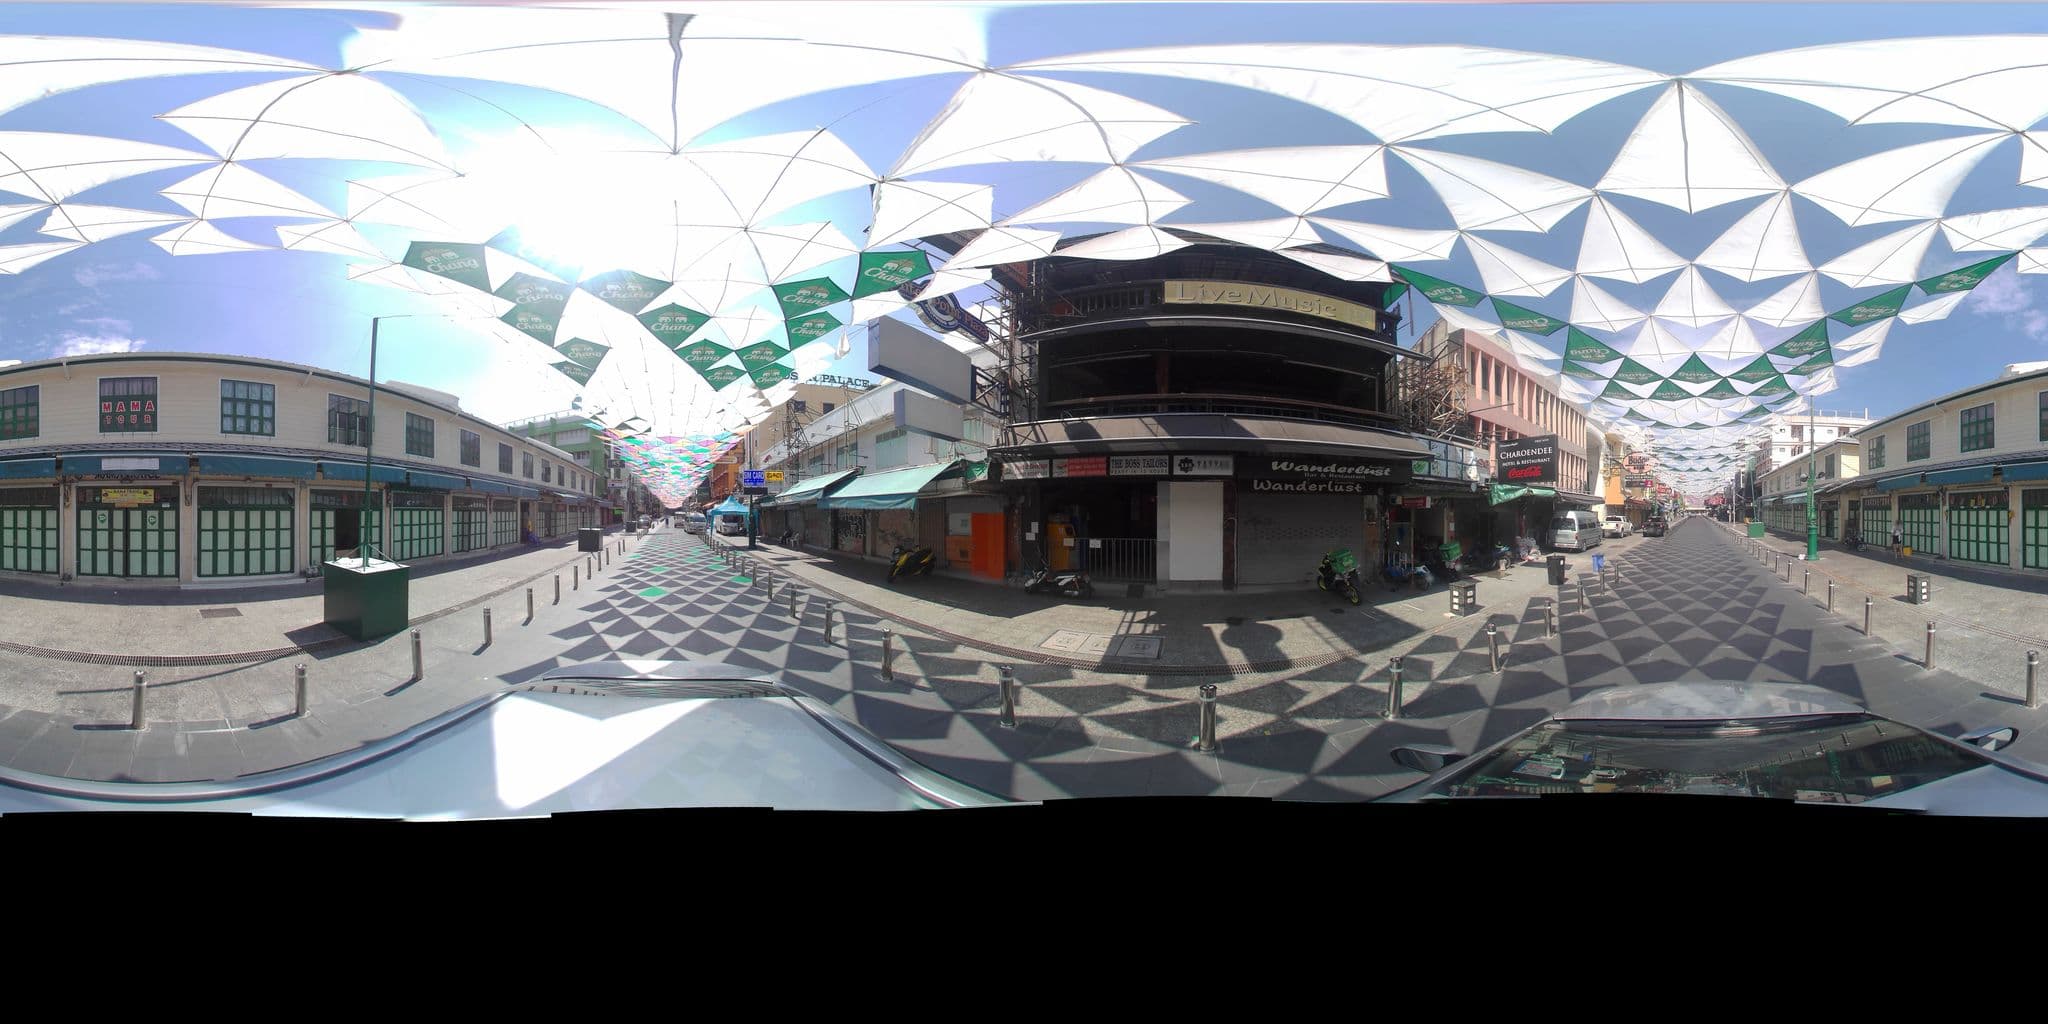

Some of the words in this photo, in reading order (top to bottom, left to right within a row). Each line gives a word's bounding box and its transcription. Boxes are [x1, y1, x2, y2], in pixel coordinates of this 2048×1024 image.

[427, 258, 480, 273] Chang
[864, 268, 909, 283] Chang
[516, 289, 564, 304] Chang
[783, 294, 830, 306] Chang
[516, 322, 552, 332] Chang
[651, 323, 695, 332] Chang
[791, 326, 826, 336] Chang
[568, 349, 601, 358] Chang
[685, 354, 721, 362] Chang
[743, 354, 776, 362] Chang
[822, 374, 870, 388] PALACE
[102, 400, 155, 412] MAMA
[1500, 447, 1553, 460] CHAROENDEE
[1111, 458, 1123, 468] THE
[1124, 458, 1141, 468] BOSS
[1142, 457, 1168, 468] TAILORS
[1271, 460, 1392, 476] Wanderlust
[1253, 479, 1363, 493] Wanderlust
